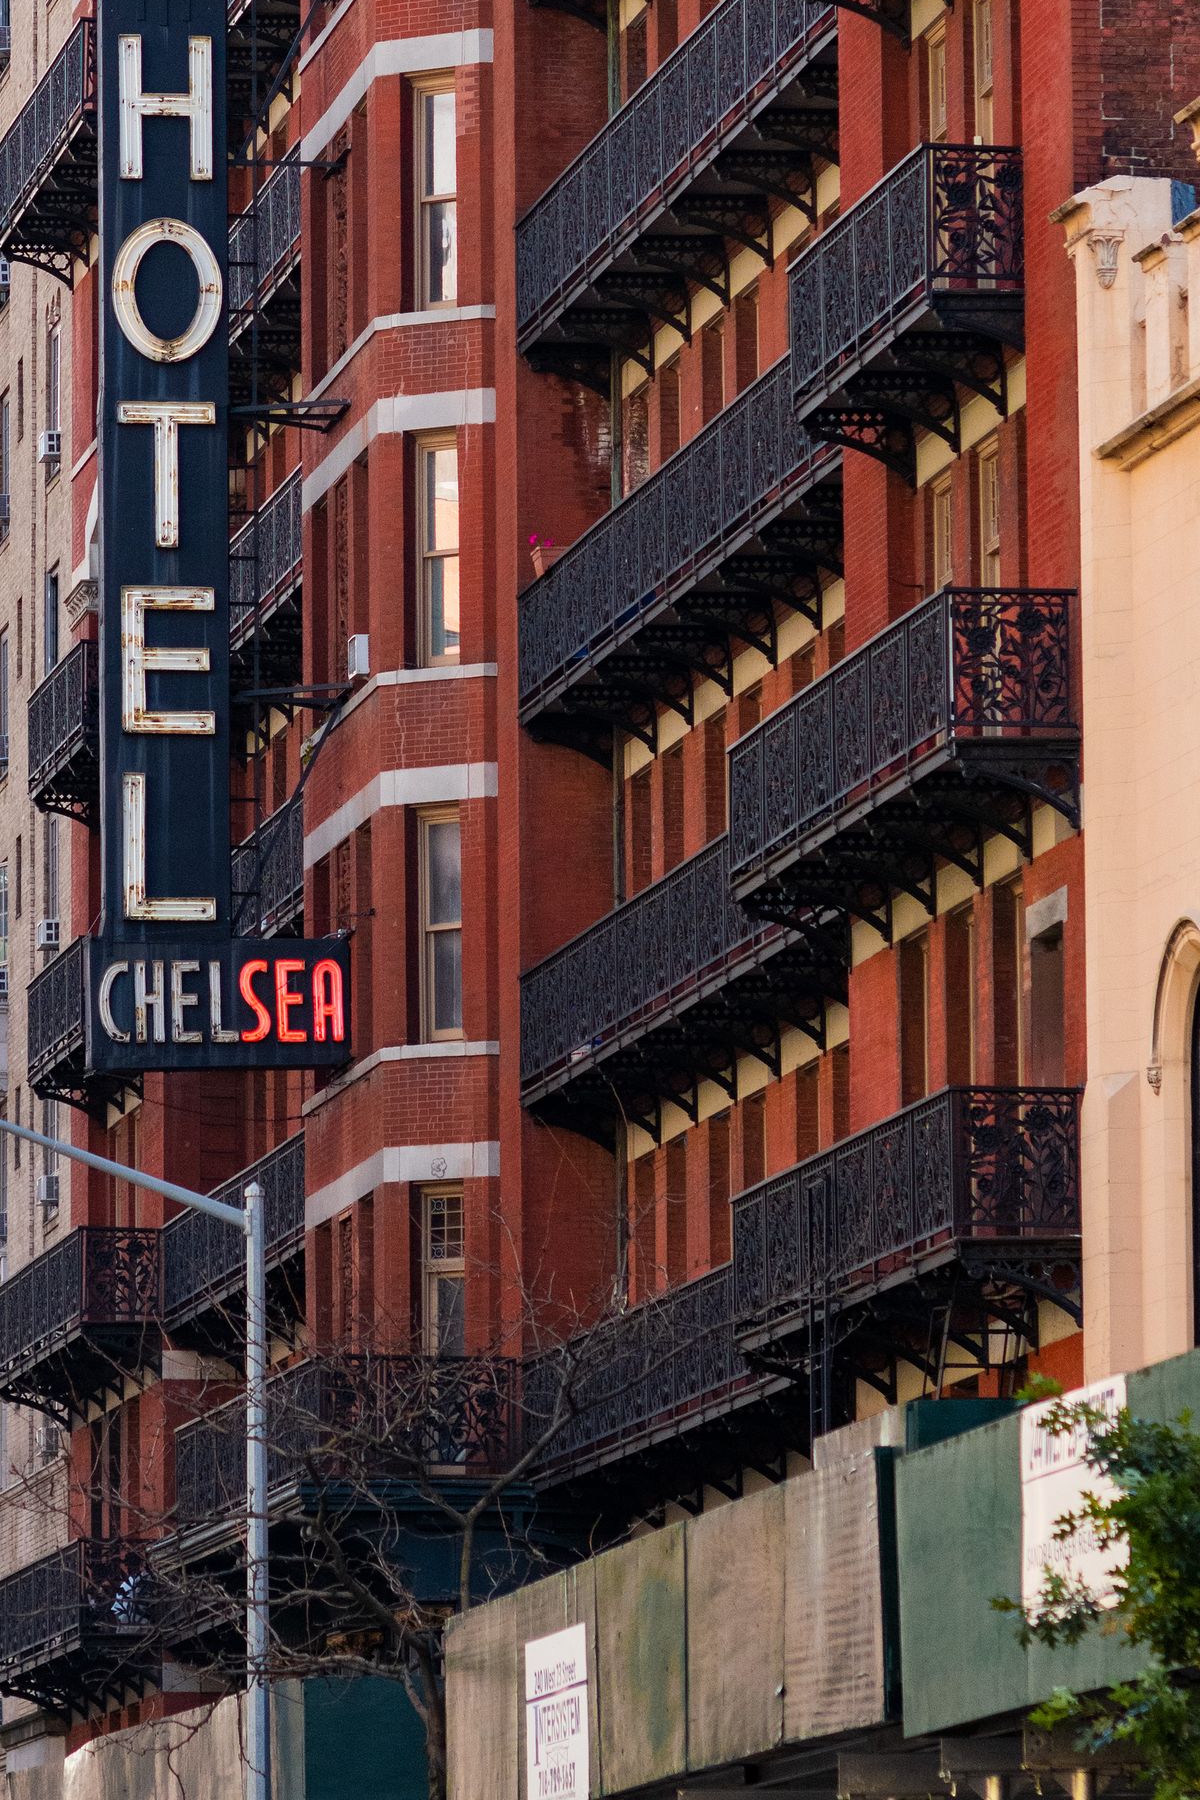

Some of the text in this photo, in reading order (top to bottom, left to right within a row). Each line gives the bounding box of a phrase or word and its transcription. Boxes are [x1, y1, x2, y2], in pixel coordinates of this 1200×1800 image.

[112, 33, 223, 922] HOTEL
[98, 958, 345, 1044] CHELSEA
[534, 1669, 543, 1695] 240
[543, 1665, 555, 1692] West
[562, 1658, 576, 1684] Street
